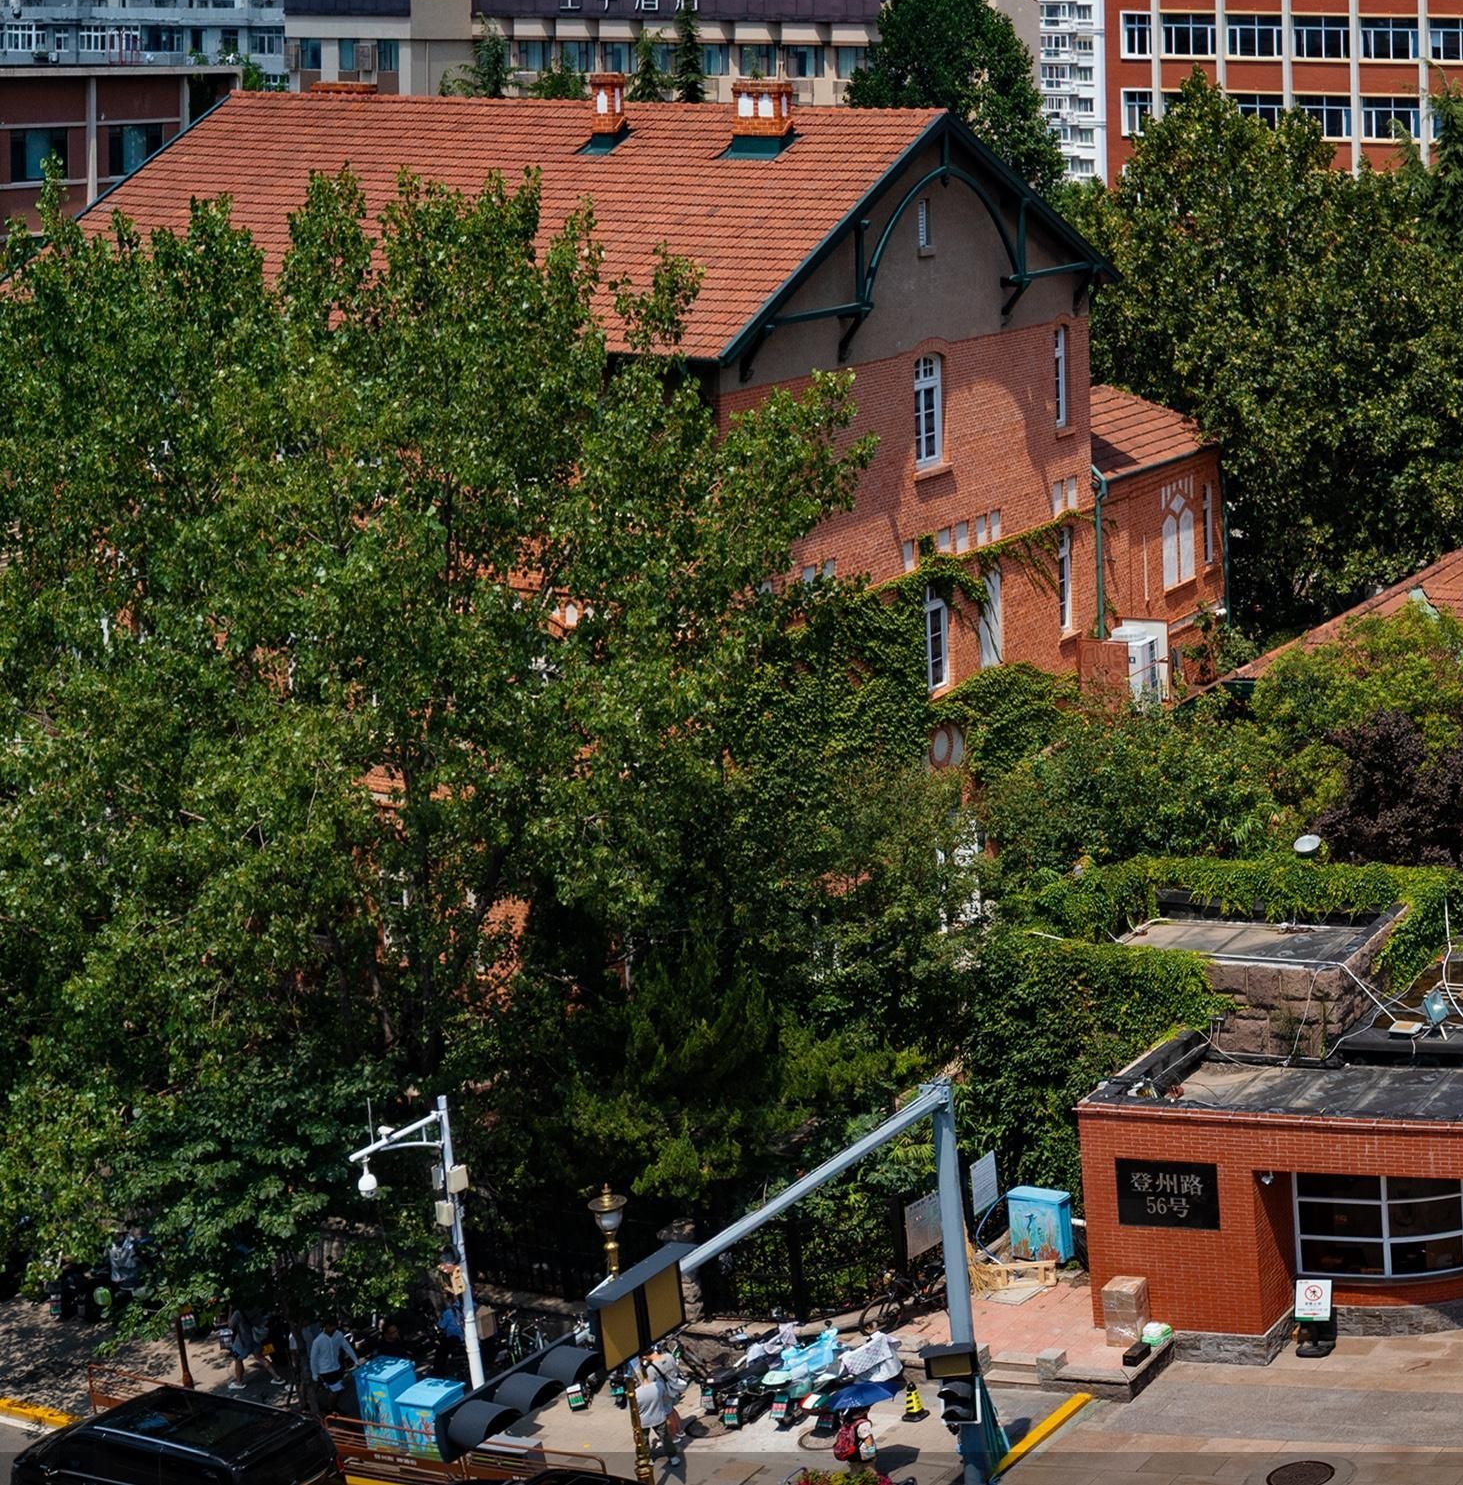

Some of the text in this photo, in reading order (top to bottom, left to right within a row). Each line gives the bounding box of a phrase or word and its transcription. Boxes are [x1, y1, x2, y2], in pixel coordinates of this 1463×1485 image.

[1131, 1171, 1204, 1197] 登州路
[1146, 1196, 1191, 1218] 56号
